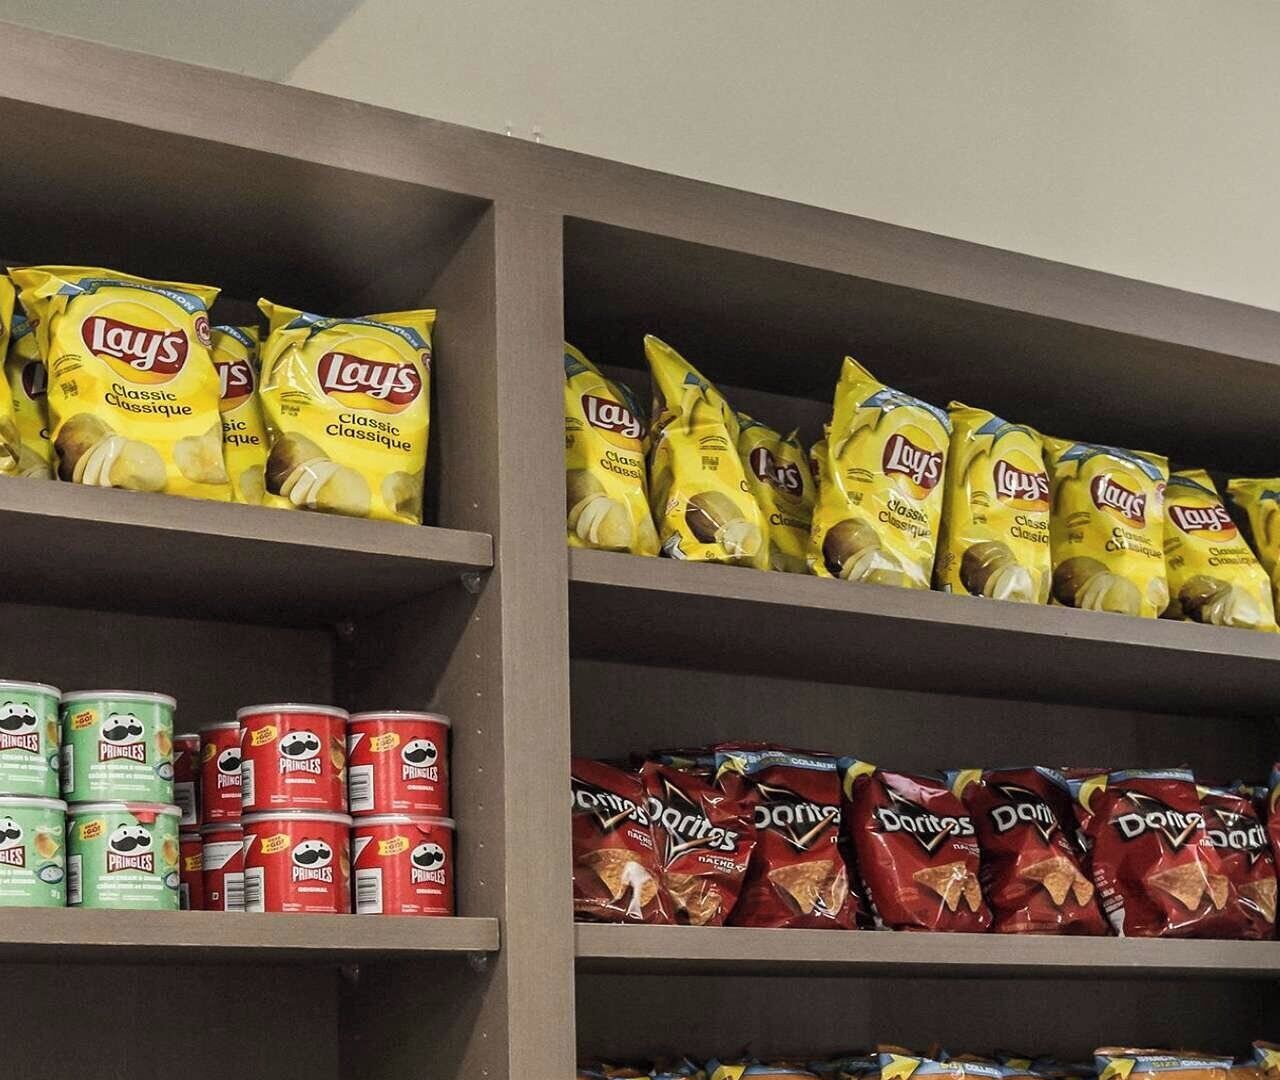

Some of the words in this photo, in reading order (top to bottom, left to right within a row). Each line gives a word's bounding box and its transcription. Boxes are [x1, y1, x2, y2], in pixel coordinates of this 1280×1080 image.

[92, 318, 184, 371] Lay's
[325, 354, 417, 399] Lay's
[105, 392, 193, 418] Classique
[112, 383, 178, 402] Classic
[338, 413, 400, 437] Classic
[326, 424, 412, 452] Classique
[886, 434, 943, 486] Lay's
[998, 459, 1049, 503] Lay's
[1097, 473, 1146, 518] Lay's
[877, 510, 932, 540] Classique
[886, 499, 928, 526] Classic
[1177, 504, 1230, 533] Lay's
[1111, 526, 1153, 546] Classic
[99, 743, 145, 762] PRINGLES
[279, 757, 321, 775] PRINGLES
[402, 765, 438, 783] PRINGLES
[284, 777, 317, 785] ORIGINAL
[647, 797, 739, 851] Doritos
[879, 808, 975, 837] Doritos
[108, 852, 153, 873] PRINGLES
[698, 855, 736, 869] NACHO
[292, 866, 334, 884] PRINGLES
[411, 869, 446, 885] PRINGLES
[297, 886, 329, 894] ORIGINAL
